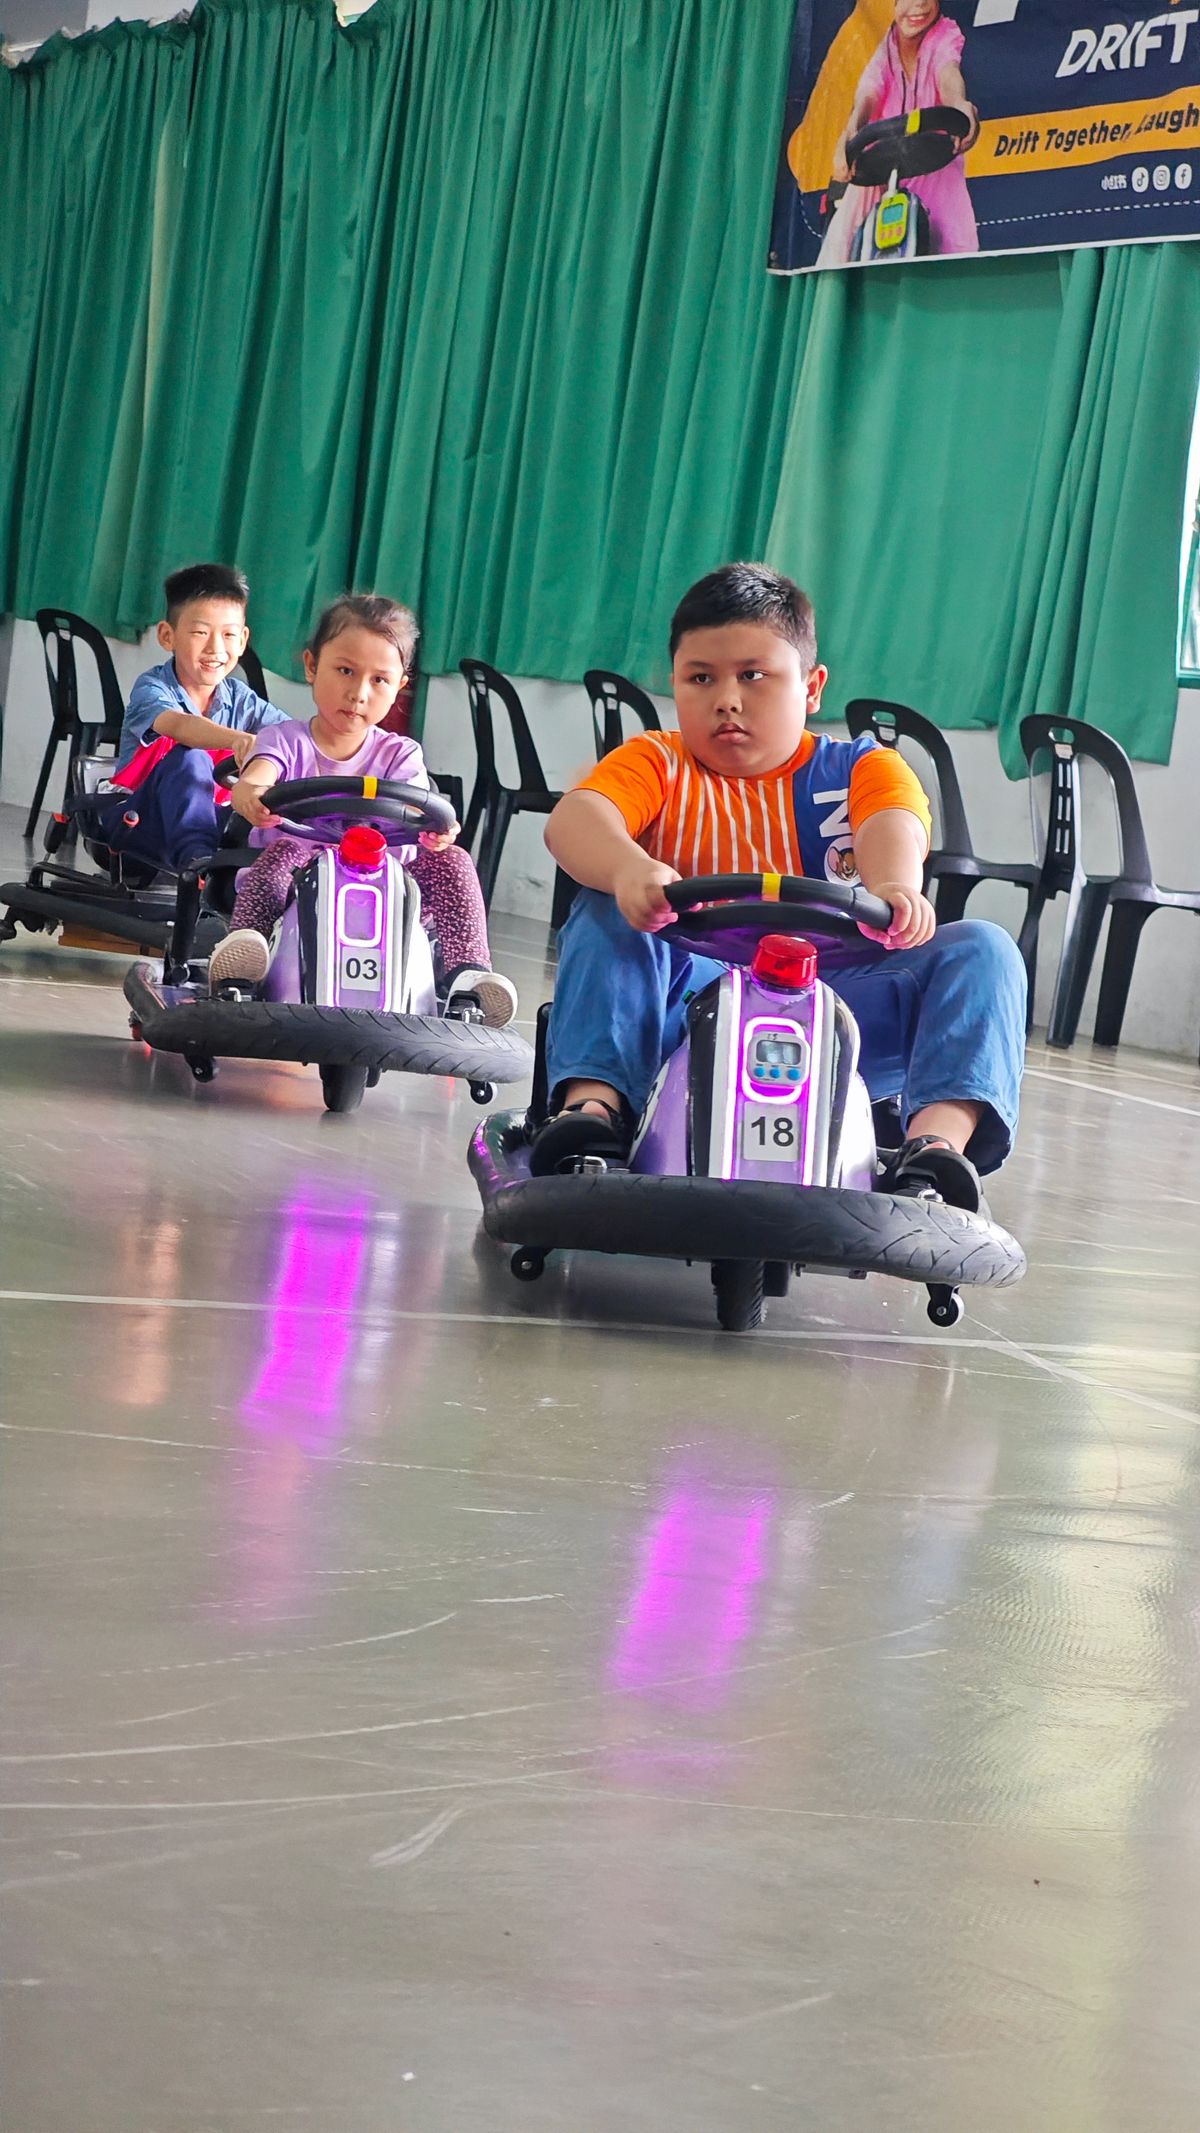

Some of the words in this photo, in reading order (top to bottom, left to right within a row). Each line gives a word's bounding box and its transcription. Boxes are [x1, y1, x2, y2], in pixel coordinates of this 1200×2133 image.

[1055, 9, 1199, 78] DRIFT
[993, 130, 1040, 157] Drift
[345, 957, 378, 980] 03
[751, 1116, 795, 1147] 18
